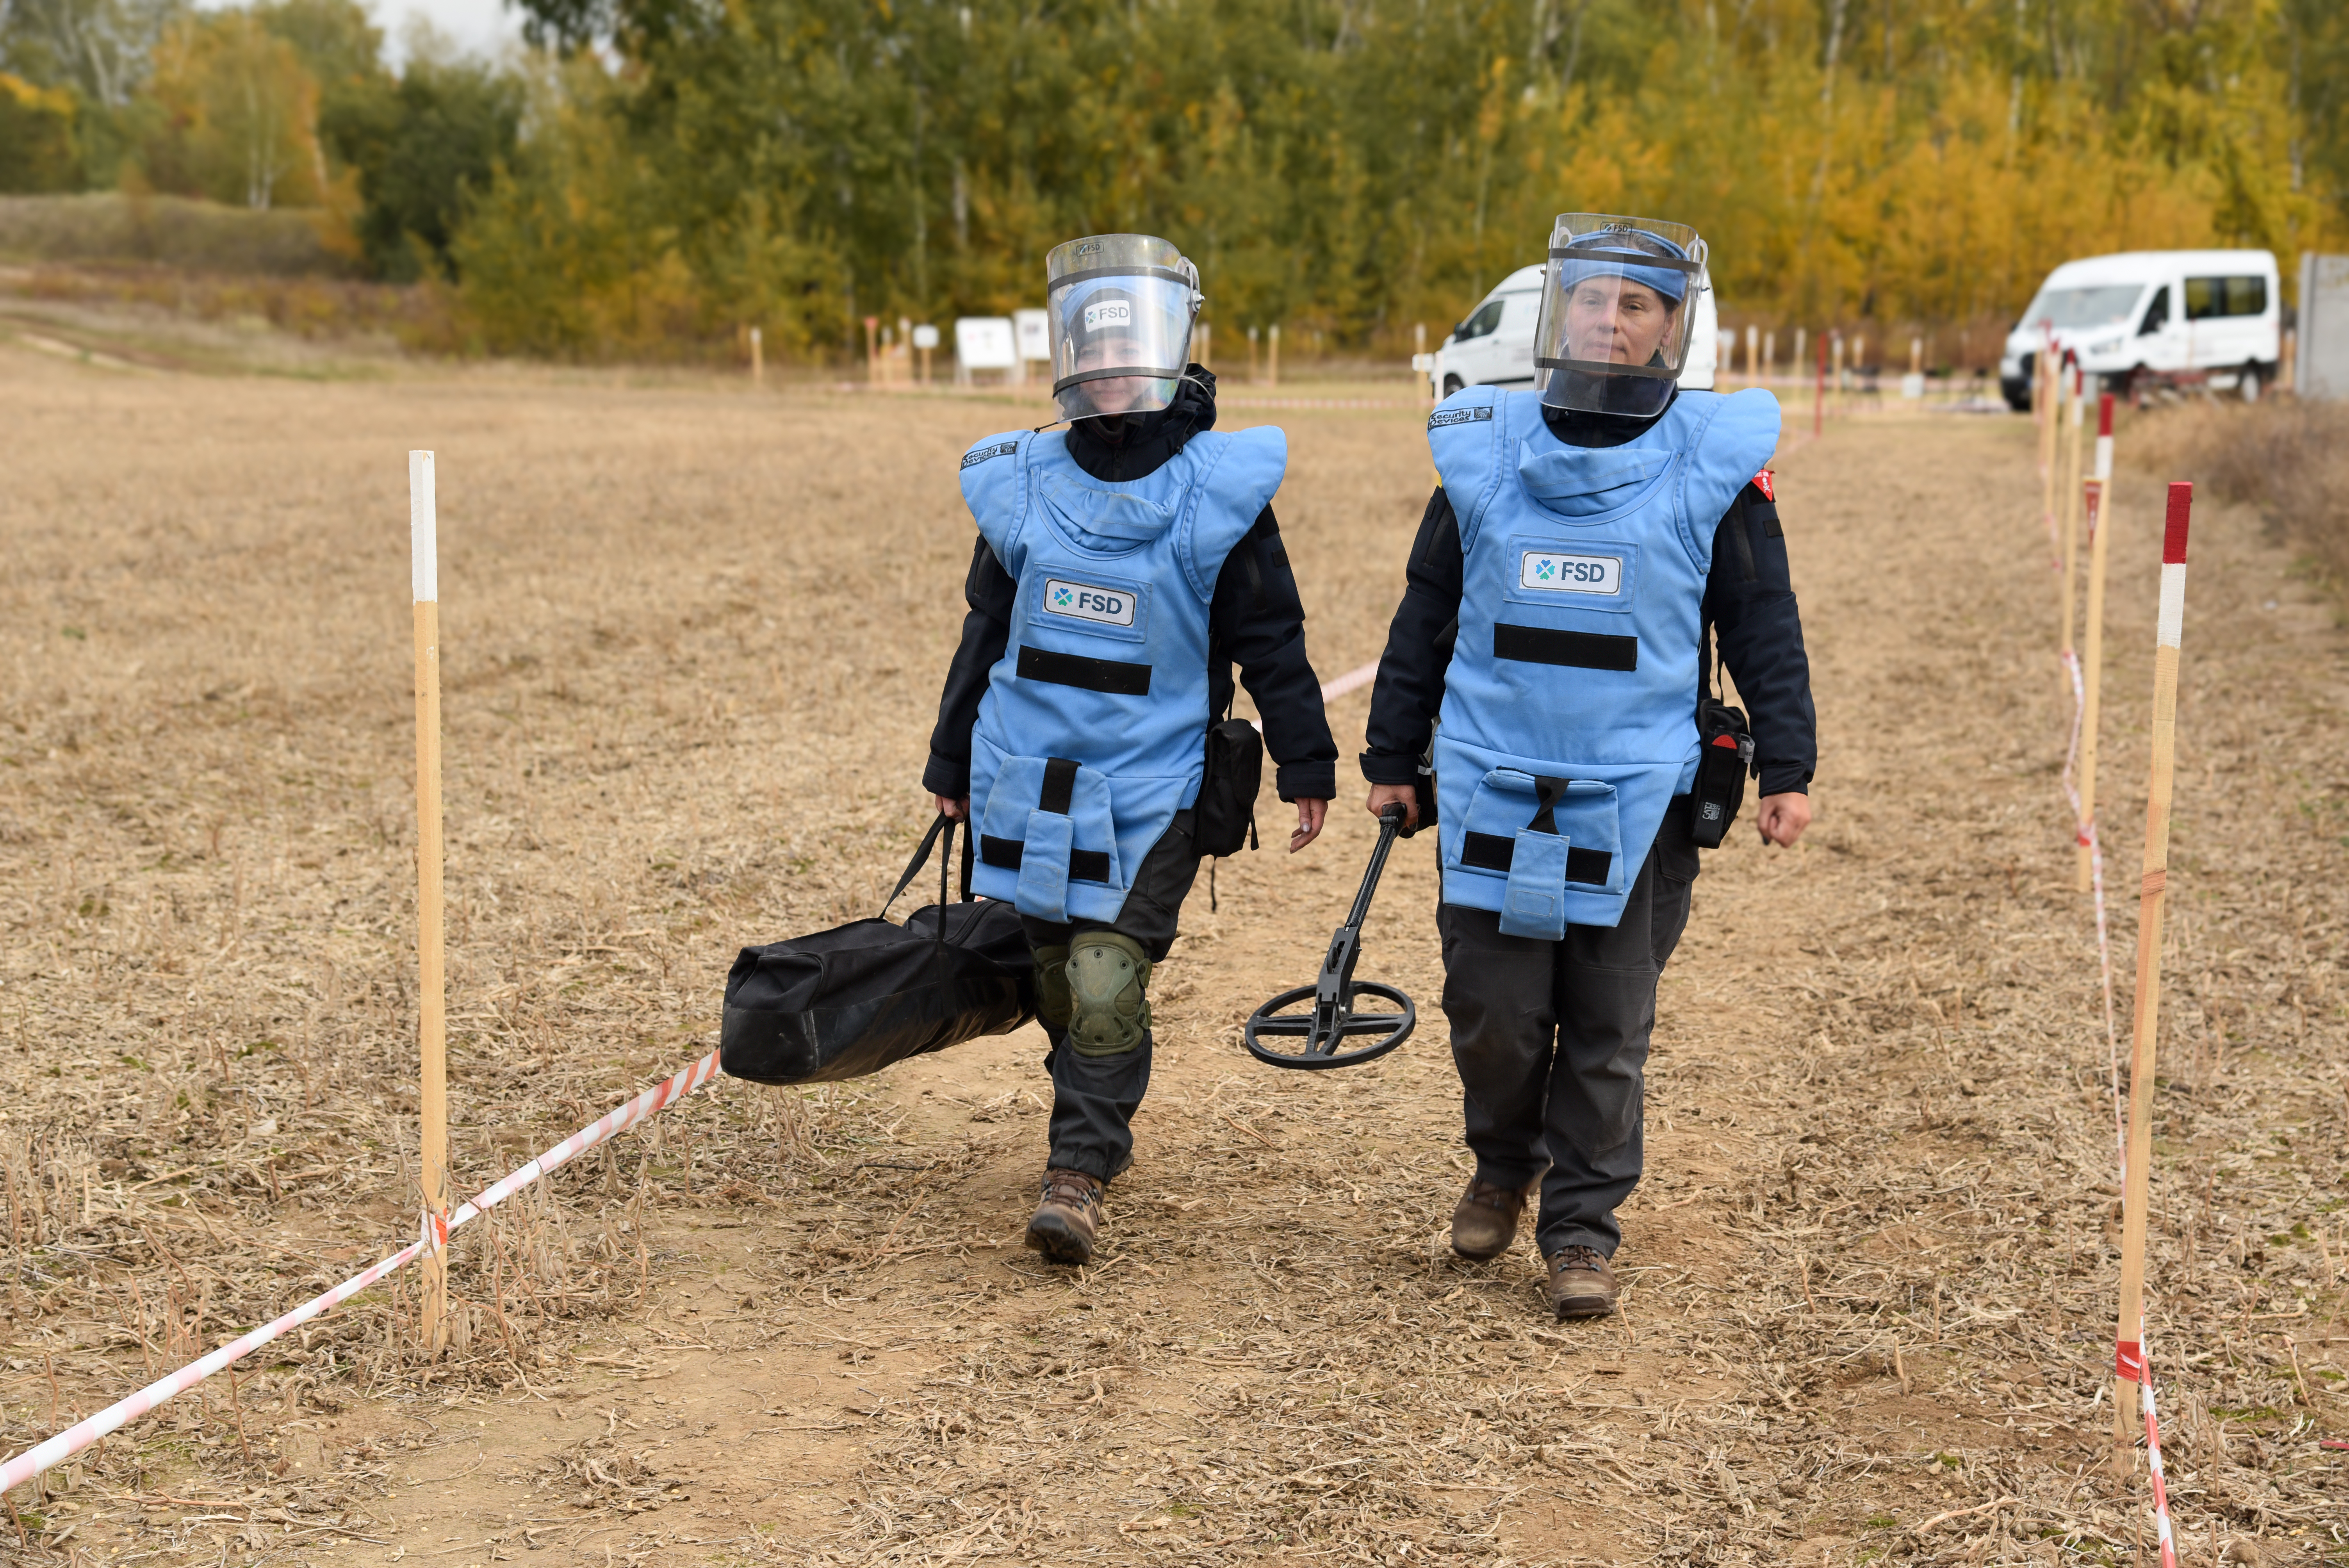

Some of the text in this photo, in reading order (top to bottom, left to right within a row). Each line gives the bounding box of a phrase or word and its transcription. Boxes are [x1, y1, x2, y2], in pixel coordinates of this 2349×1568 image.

[1613, 224, 1628, 232] FSD
[1087, 244, 1100, 252] FSD
[1099, 306, 1129, 320] FSD
[1430, 416, 1470, 428] Devices
[1431, 410, 1471, 421] Security
[963, 446, 998, 461] Security
[1561, 561, 1605, 583] FSD
[1079, 592, 1122, 614] FSD
